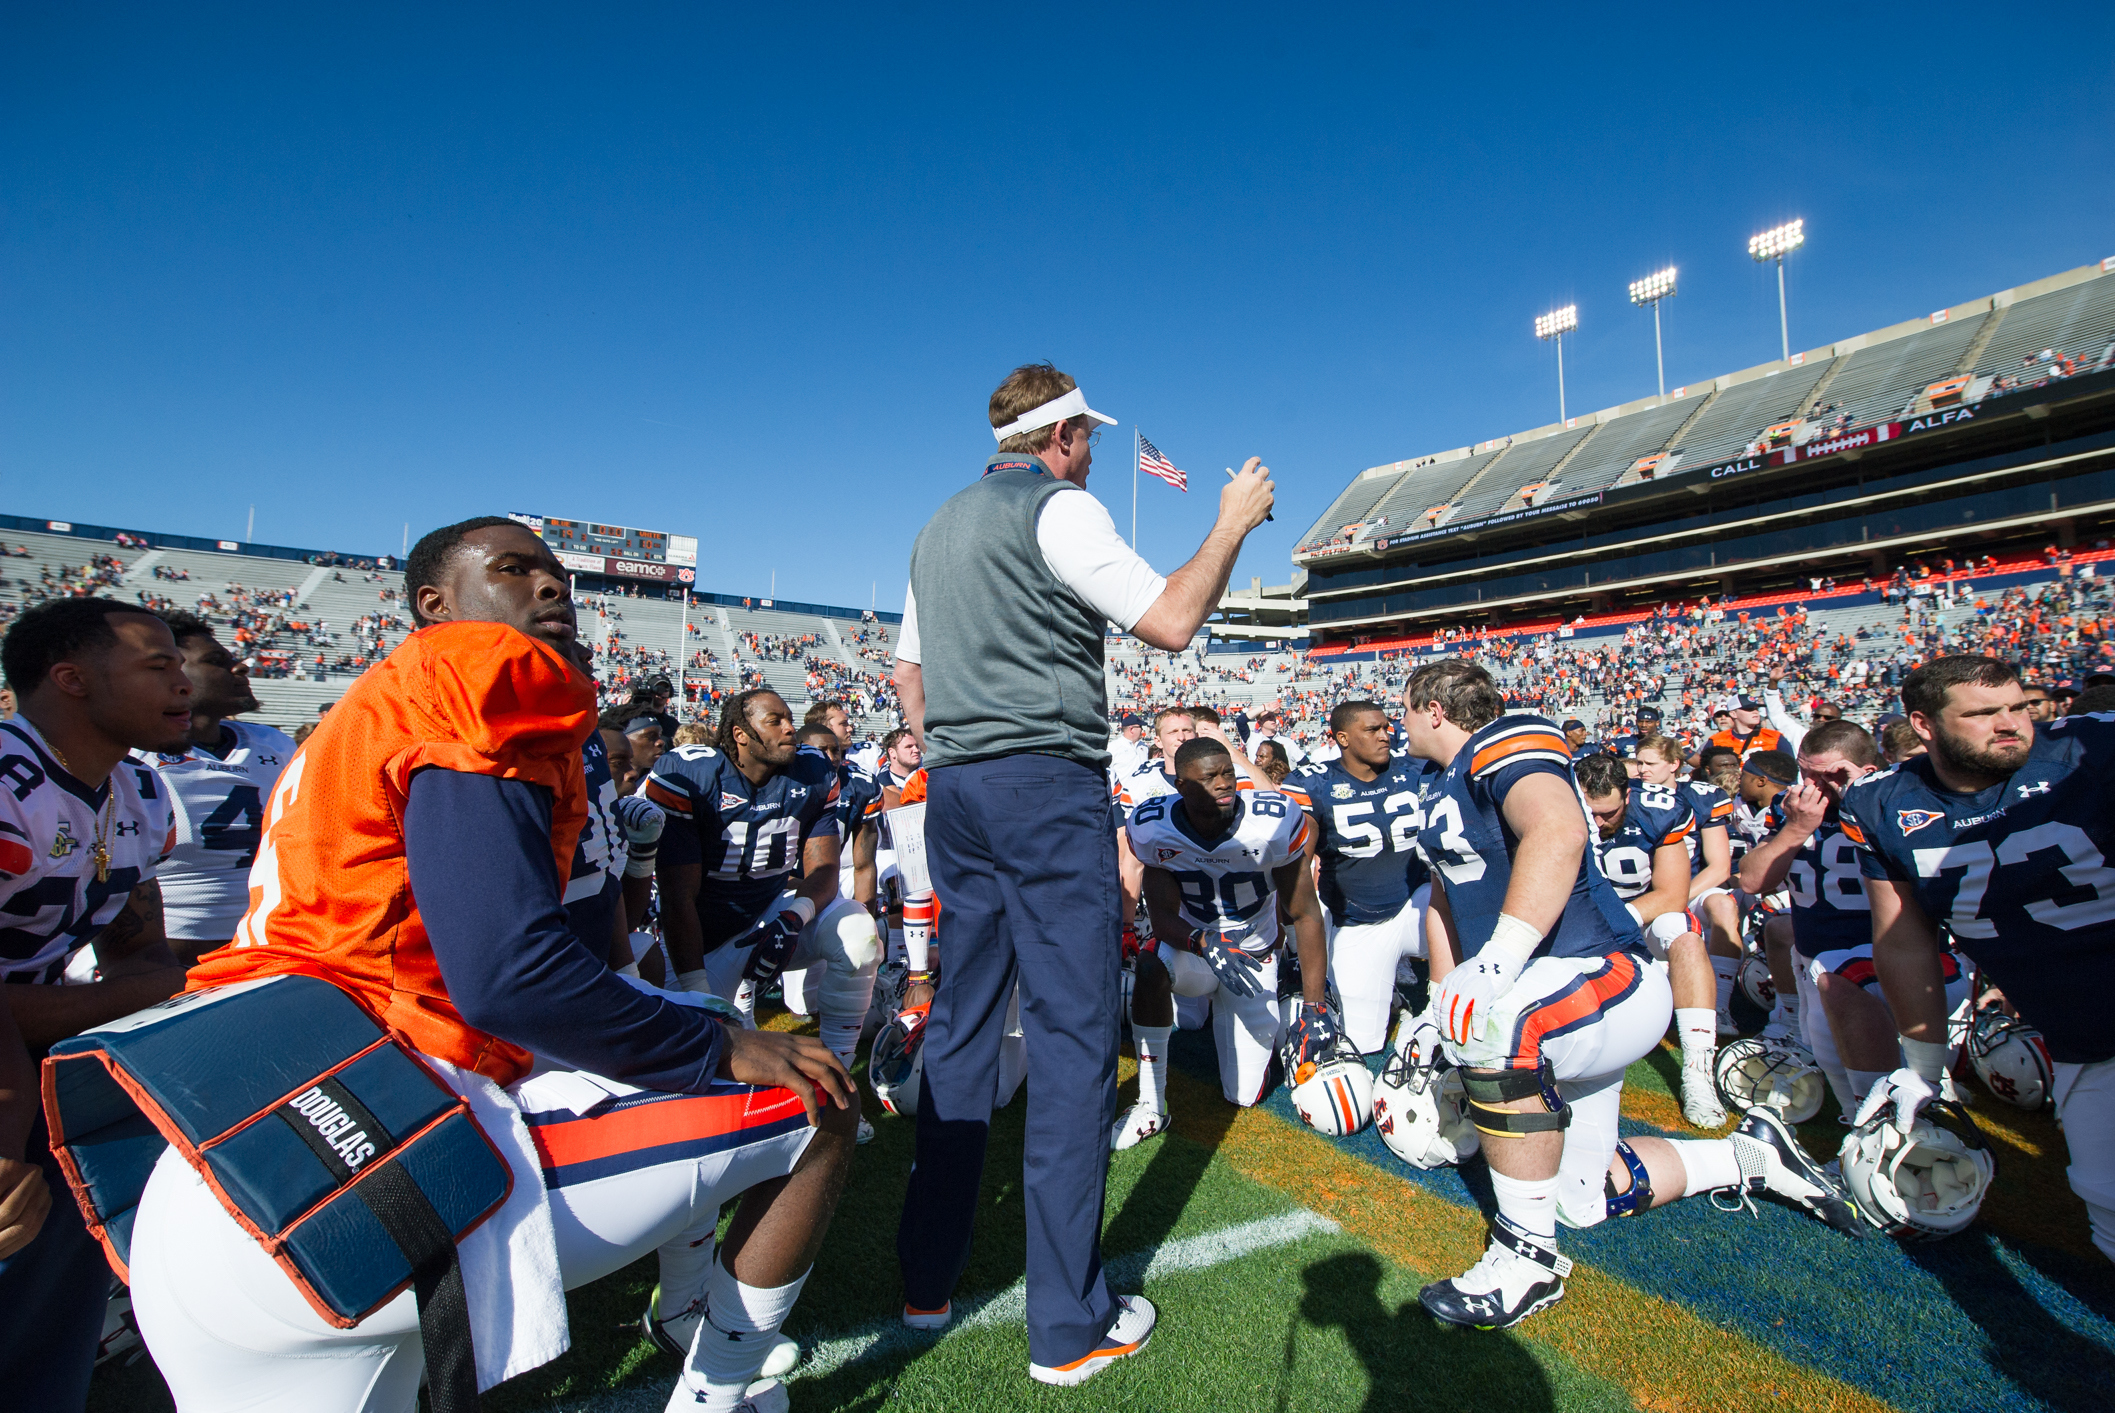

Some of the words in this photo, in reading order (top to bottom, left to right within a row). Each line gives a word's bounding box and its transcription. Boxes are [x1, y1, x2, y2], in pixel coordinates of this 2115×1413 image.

[1908, 408, 1974, 433] ALFA
[993, 462, 1031, 471] AUBURN
[1711, 460, 1761, 478] CALL
[551, 519, 571, 527] BLUE
[1420, 530, 1447, 539] ASSISTANCE
[1448, 526, 1459, 534] TEXT
[1488, 515, 1515, 525] FOLLOWED
[1541, 503, 1567, 513] MESSAGE
[561, 529, 573, 539] 19
[639, 531, 661, 539] WHITE
[590, 546, 601, 554] 10
[642, 539, 652, 549] 10
[616, 561, 657, 576] eamc
[206, 764, 249, 774] AUBURN
[1361, 787, 1388, 797] AUBURN
[750, 801, 781, 812] AUBURN
[1252, 790, 1287, 818] 80
[1333, 791, 1420, 858] 52
[1905, 812, 1925, 827] SEC
[1953, 807, 2007, 829] AUBURN
[706, 815, 801, 881] 10
[1912, 820, 2115, 939] 73
[288, 1086, 376, 1168] DOUGLAS
[1895, 1211, 1926, 1230] EAGLE
[1927, 1226, 1949, 1234] WAR
